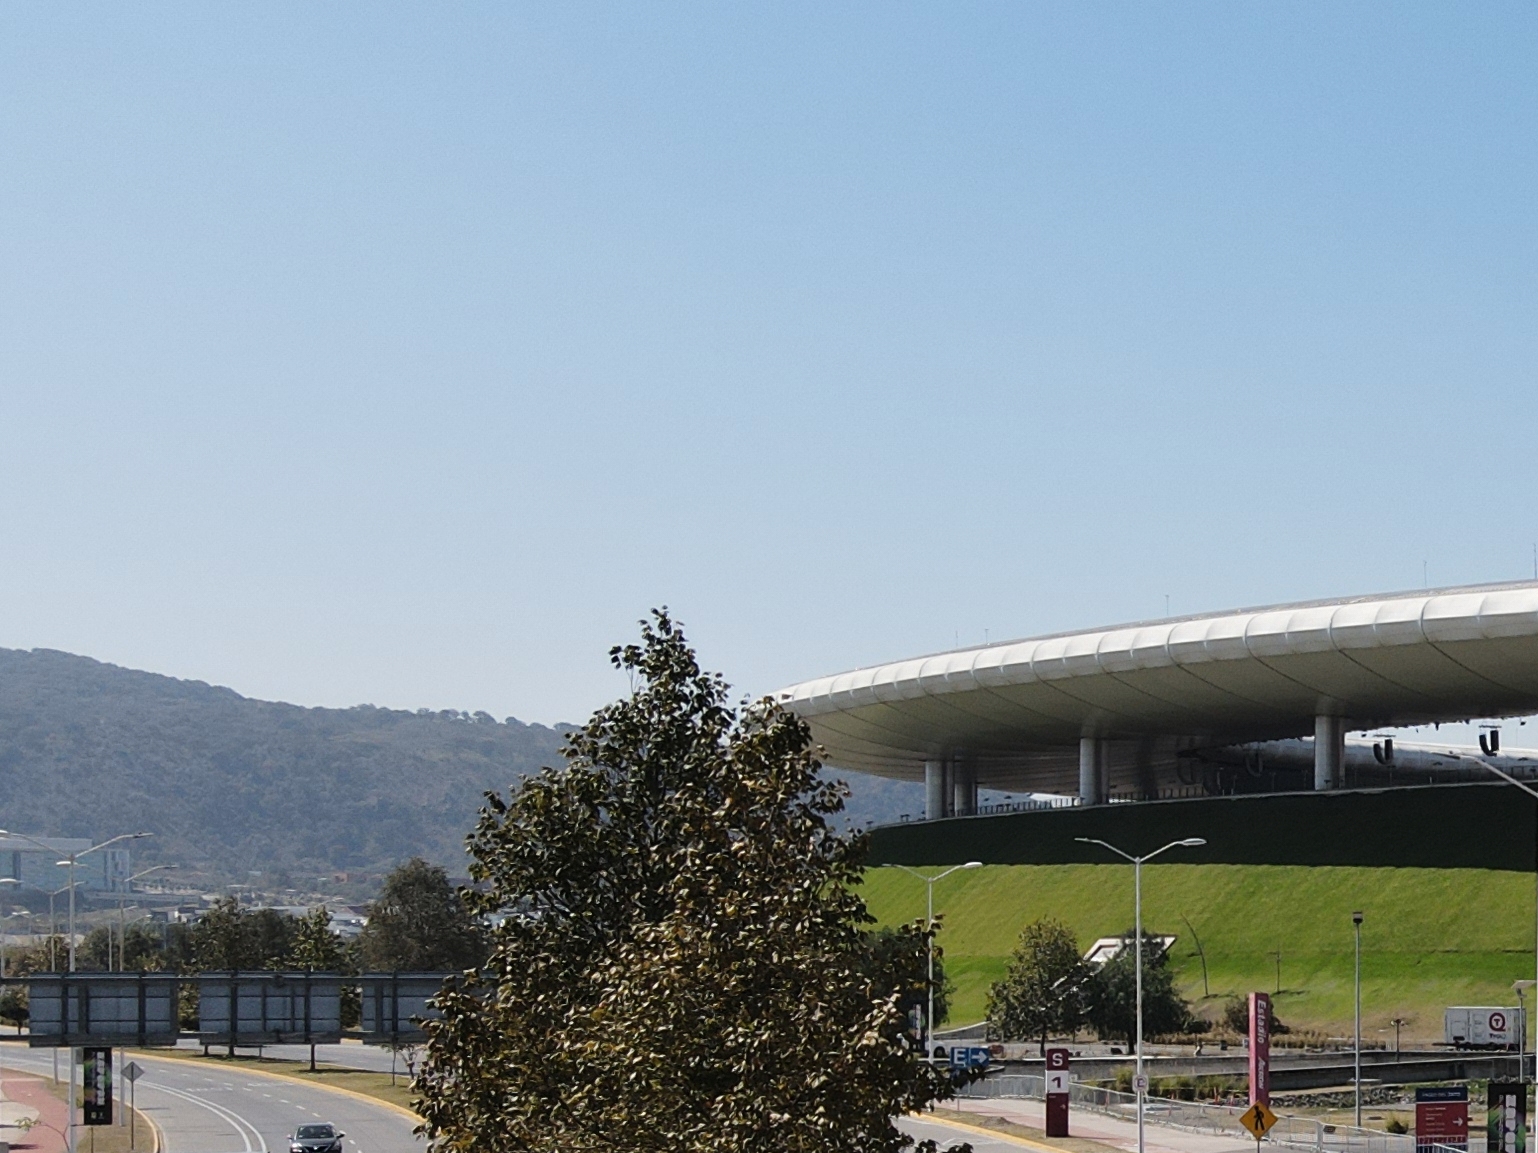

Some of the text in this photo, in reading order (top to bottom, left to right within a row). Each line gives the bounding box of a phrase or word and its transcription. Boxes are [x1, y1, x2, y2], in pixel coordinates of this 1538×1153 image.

[1257, 999, 1267, 1044] Estadio
[953, 1048, 967, 1065] E
[1052, 1052, 1063, 1067] S
[1051, 1076, 1061, 1089] 1
